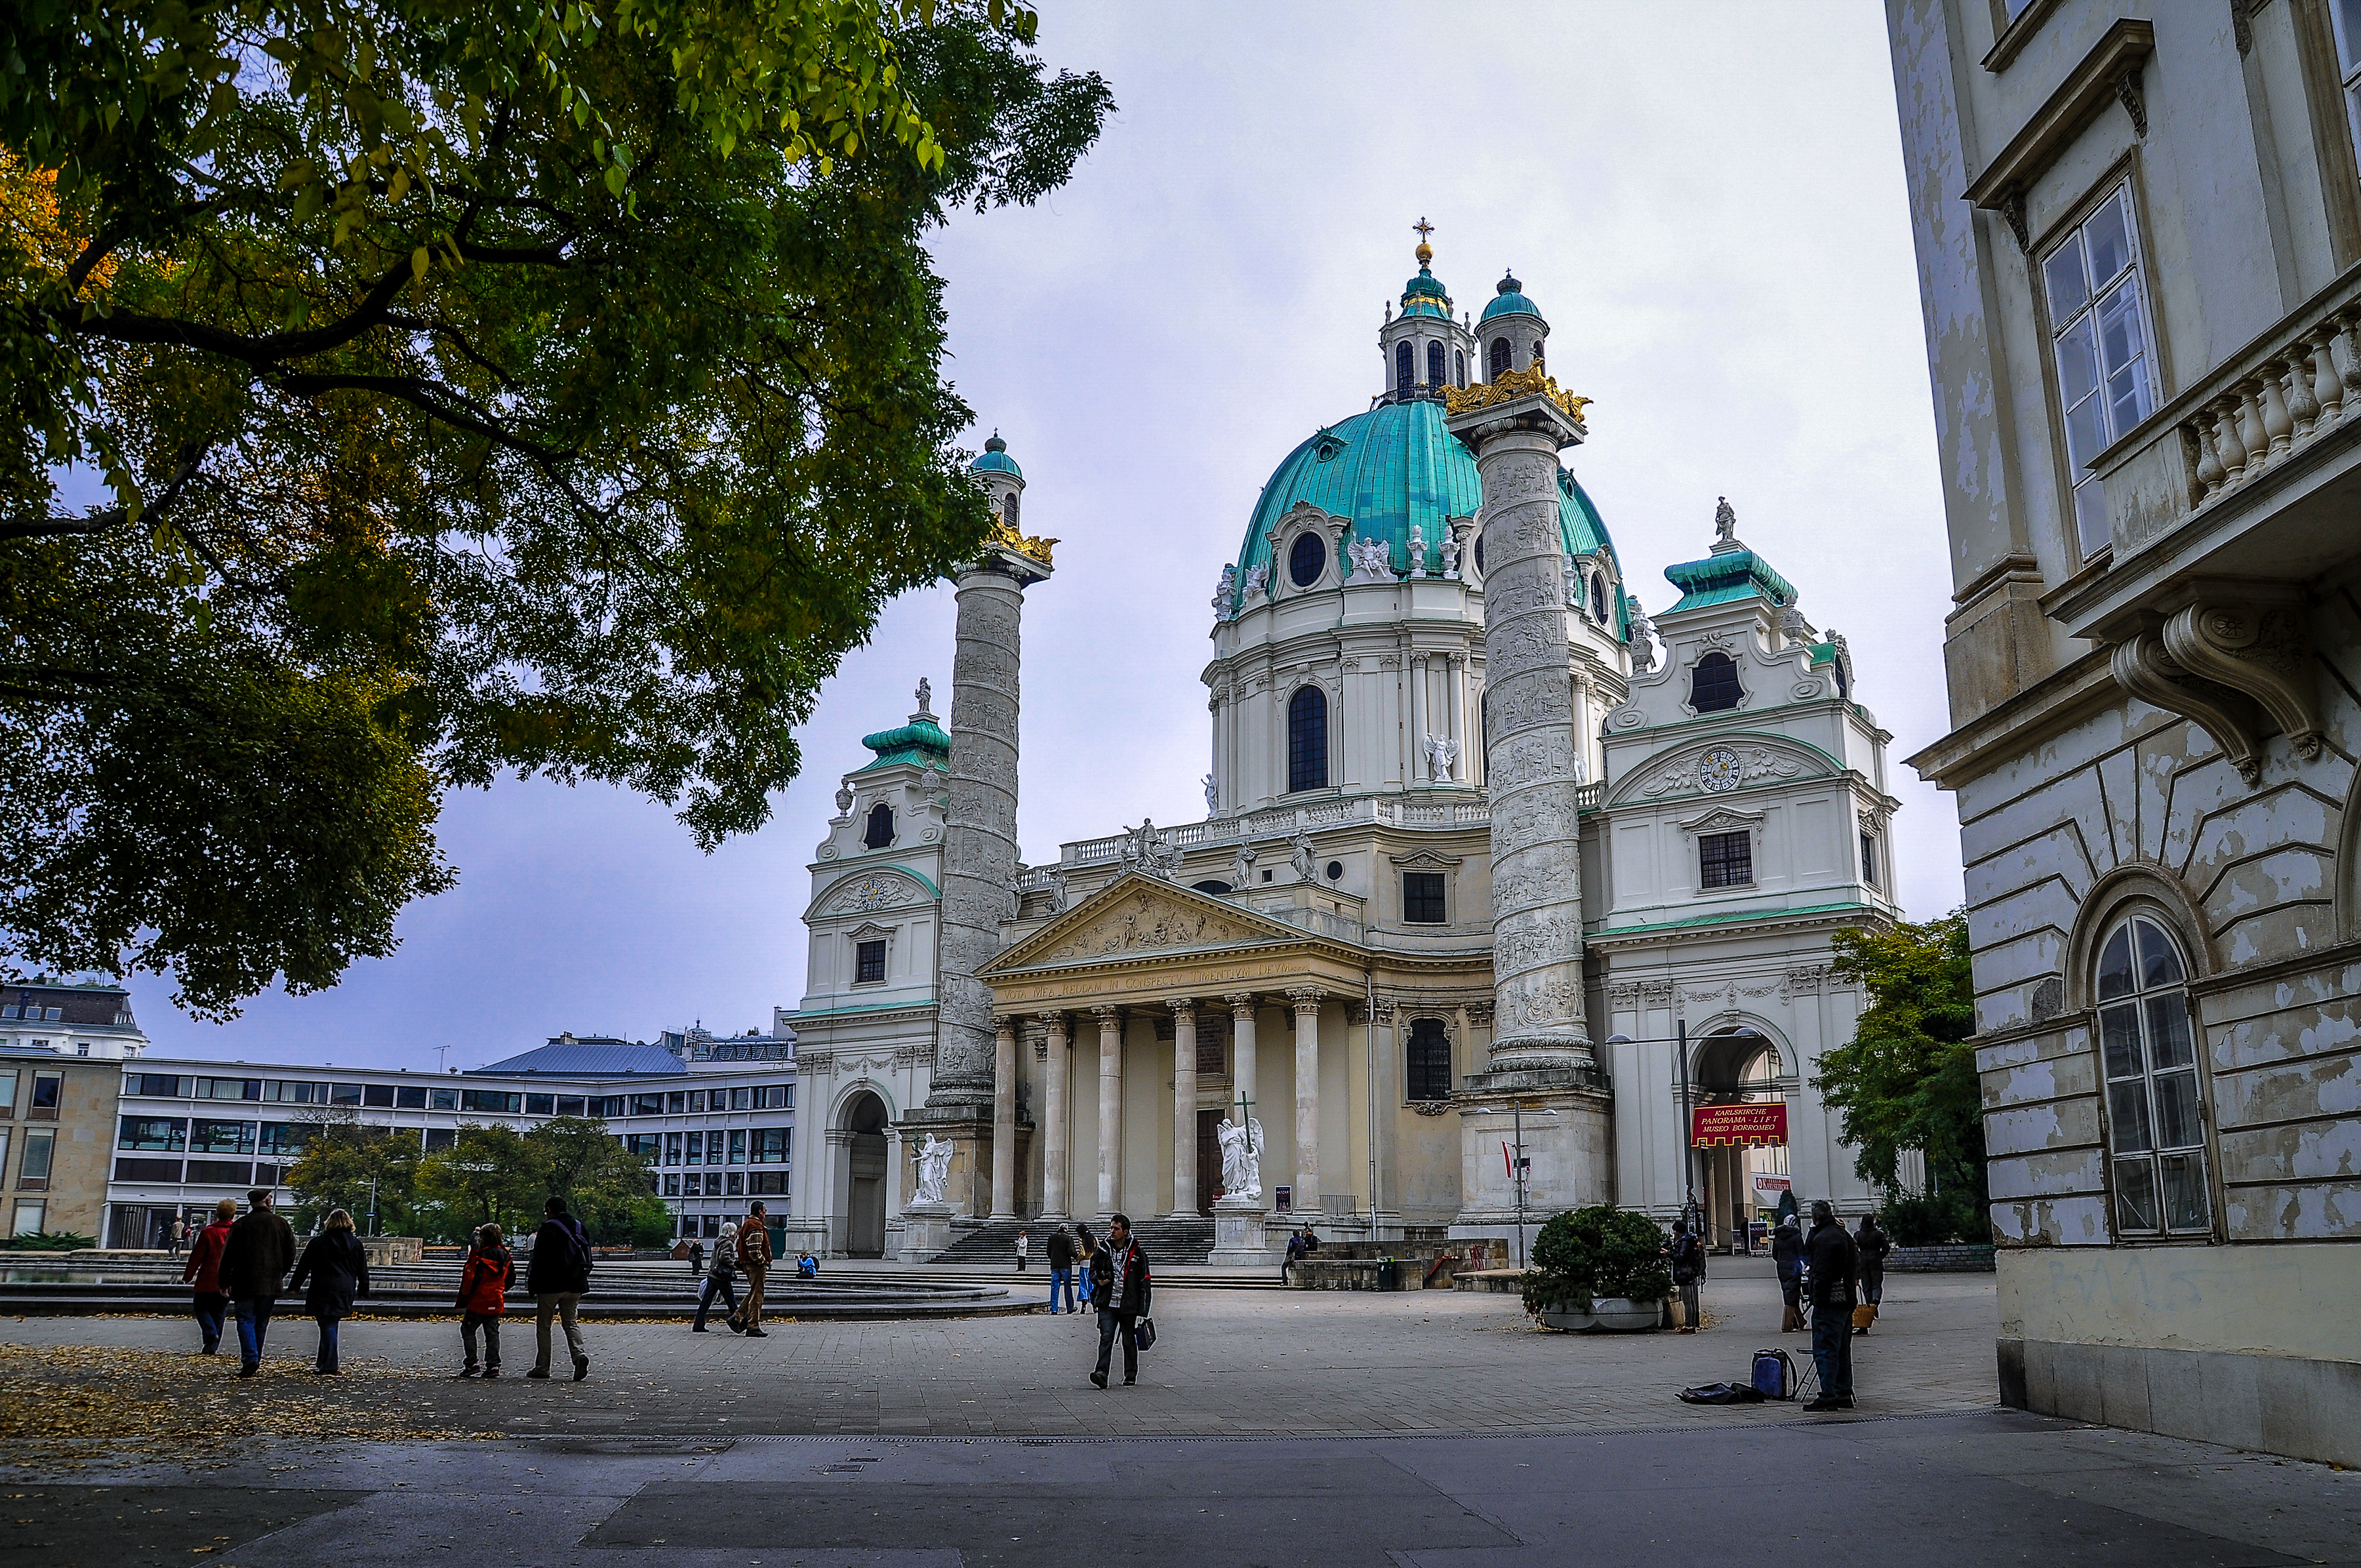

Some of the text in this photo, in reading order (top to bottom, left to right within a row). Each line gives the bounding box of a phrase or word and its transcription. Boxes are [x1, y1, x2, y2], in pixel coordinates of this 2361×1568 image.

[1004, 989, 1026, 1000] VOTA
[1033, 986, 1055, 997] MEA
[1062, 982, 1102, 995] REDDAM
[1108, 979, 1119, 990] IN
[1125, 974, 1182, 989] CONSPECTV
[1190, 967, 1251, 982] TIMENTIVM
[1257, 963, 1291, 976] DEVM
[1701, 1116, 1746, 1125] PANORAMA
